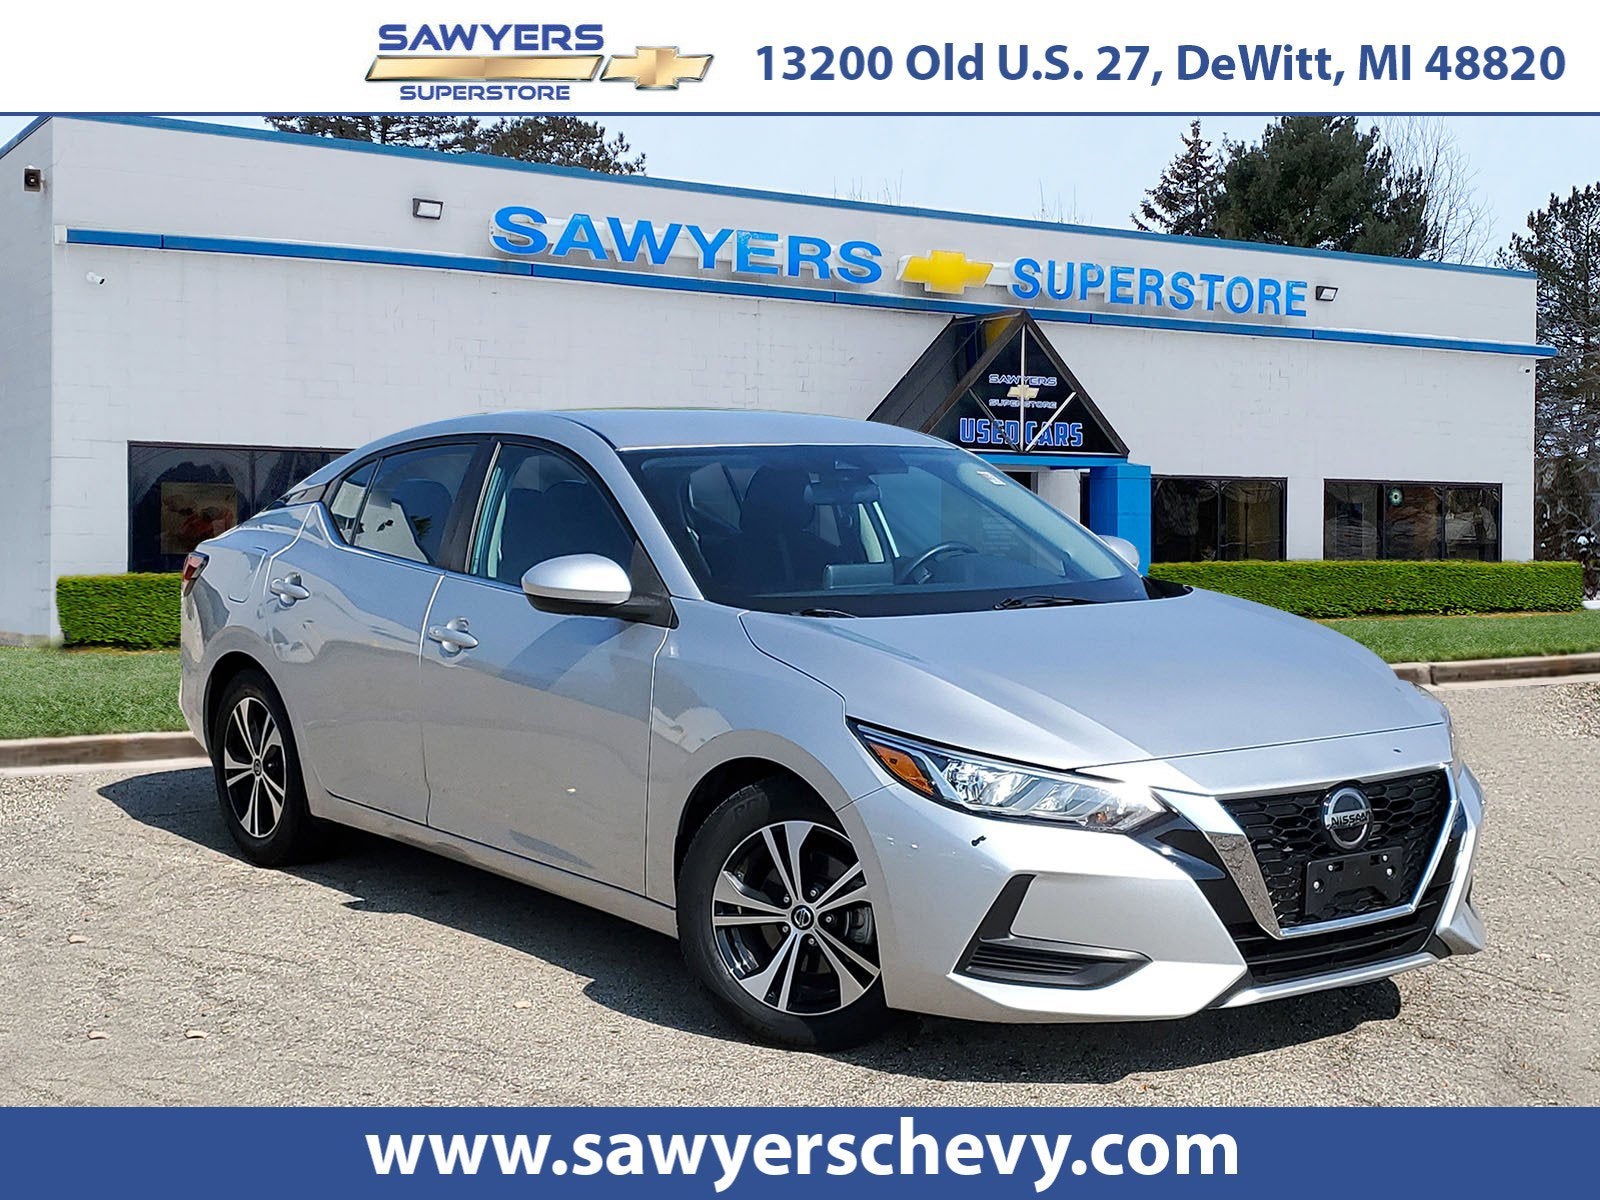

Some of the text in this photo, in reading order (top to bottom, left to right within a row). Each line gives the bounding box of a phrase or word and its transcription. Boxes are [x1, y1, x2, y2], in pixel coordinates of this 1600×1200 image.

[490, 205, 1308, 318] SAWYERS SUPERSTORE
[988, 398, 1058, 409] SUPESTORE
[959, 417, 1084, 447] USED CARS
[1331, 812, 1368, 826] NISSAN
